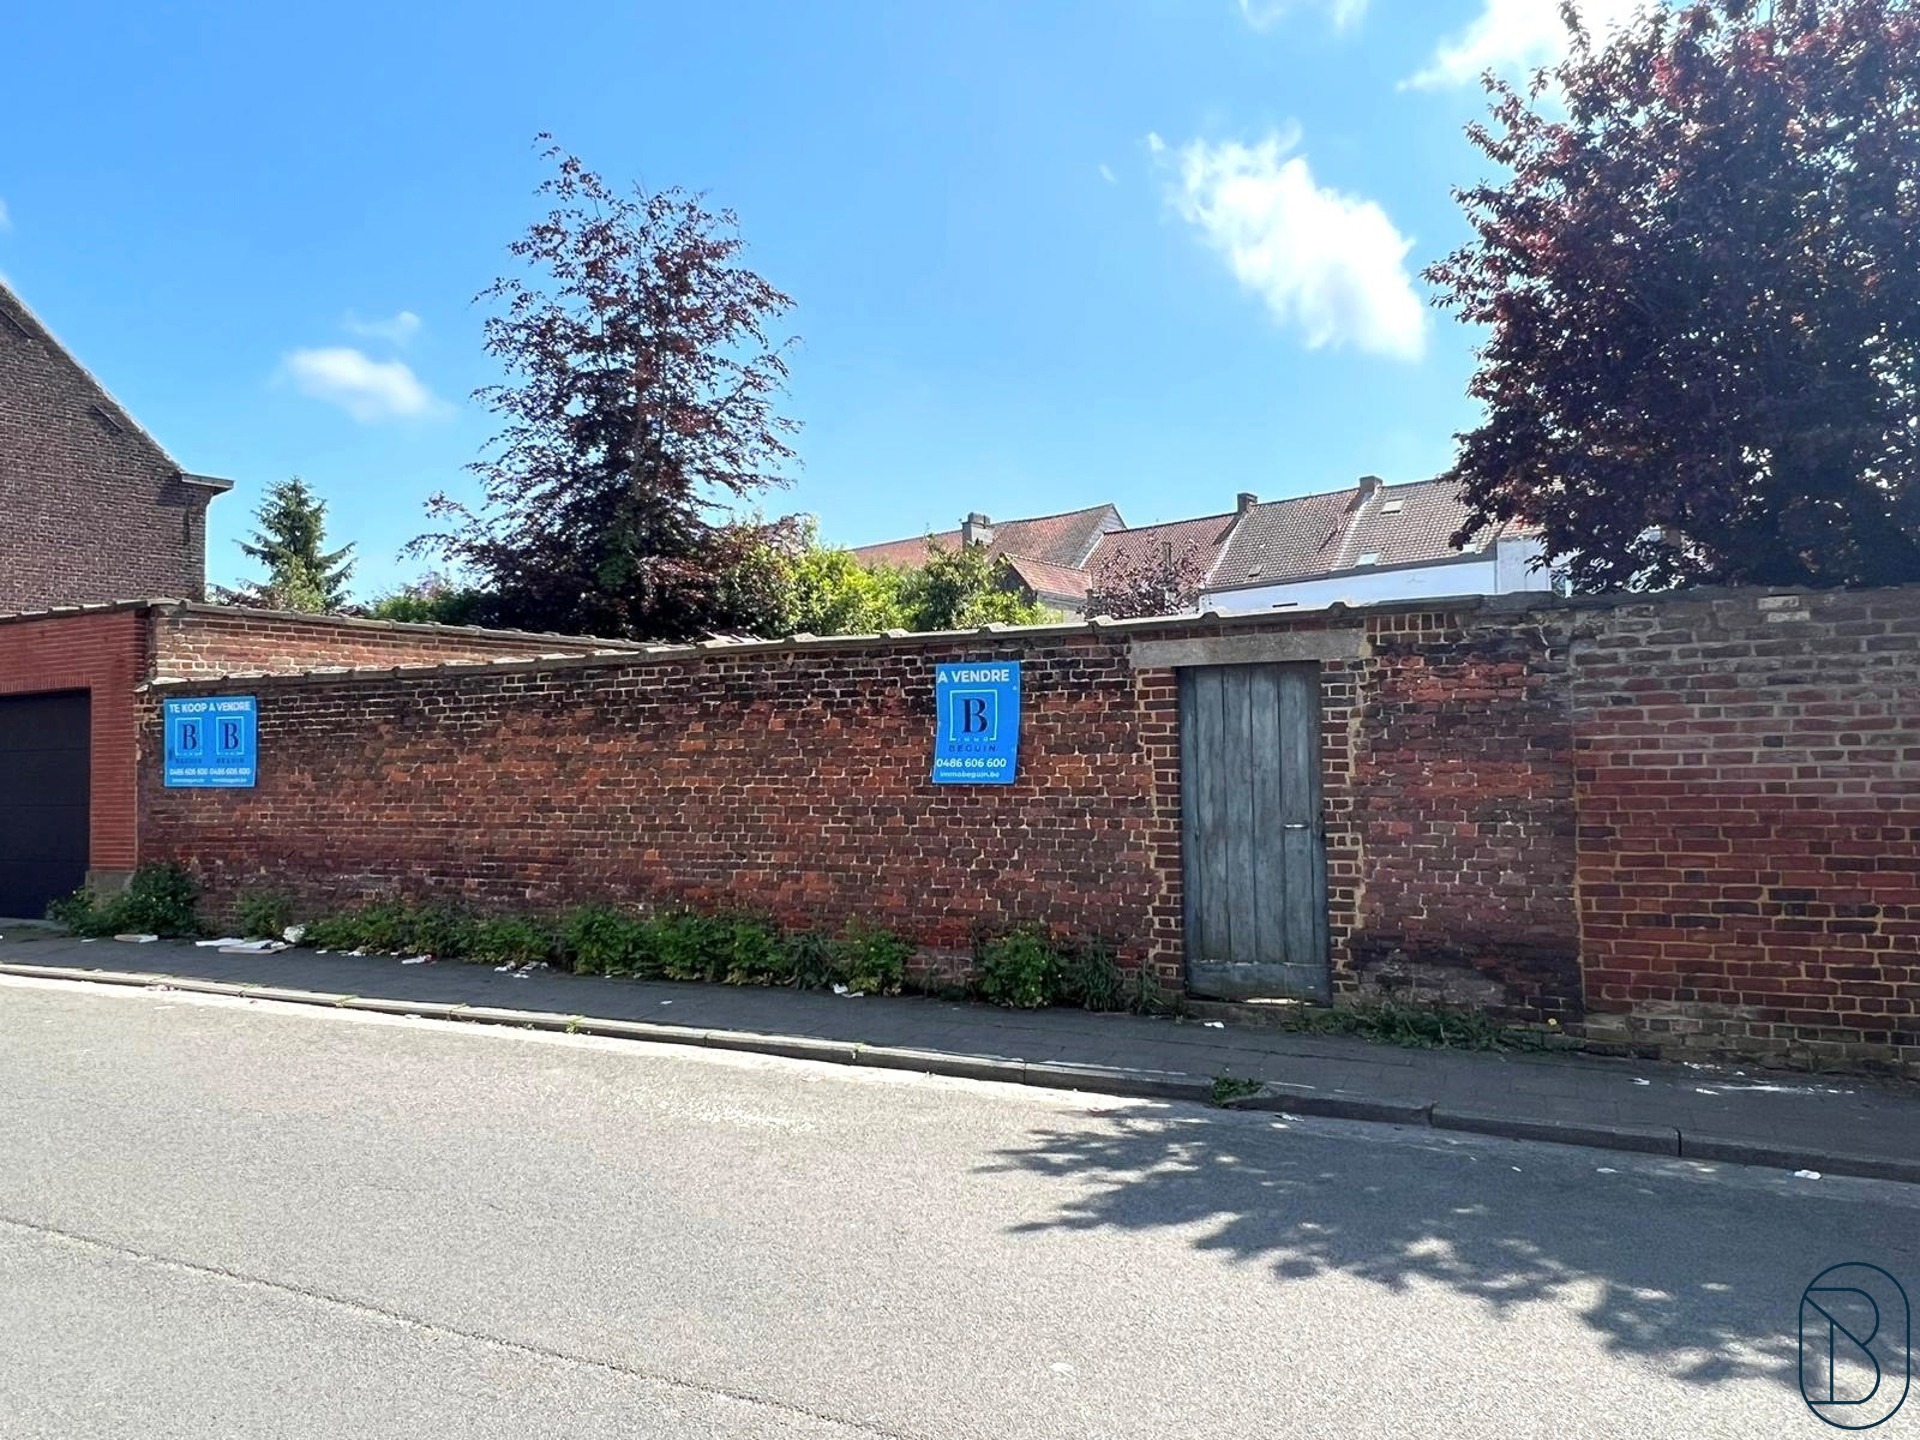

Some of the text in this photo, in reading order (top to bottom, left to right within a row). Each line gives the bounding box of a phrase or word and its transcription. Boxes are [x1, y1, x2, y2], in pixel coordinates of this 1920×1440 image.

[938, 669, 1009, 683] A VENDRE
[169, 701, 250, 713] TE KOOP A VENDRE
[962, 698, 988, 733] B
[183, 723, 197, 750] B
[224, 723, 239, 750] B
[936, 758, 1007, 767] 0486 606 600
